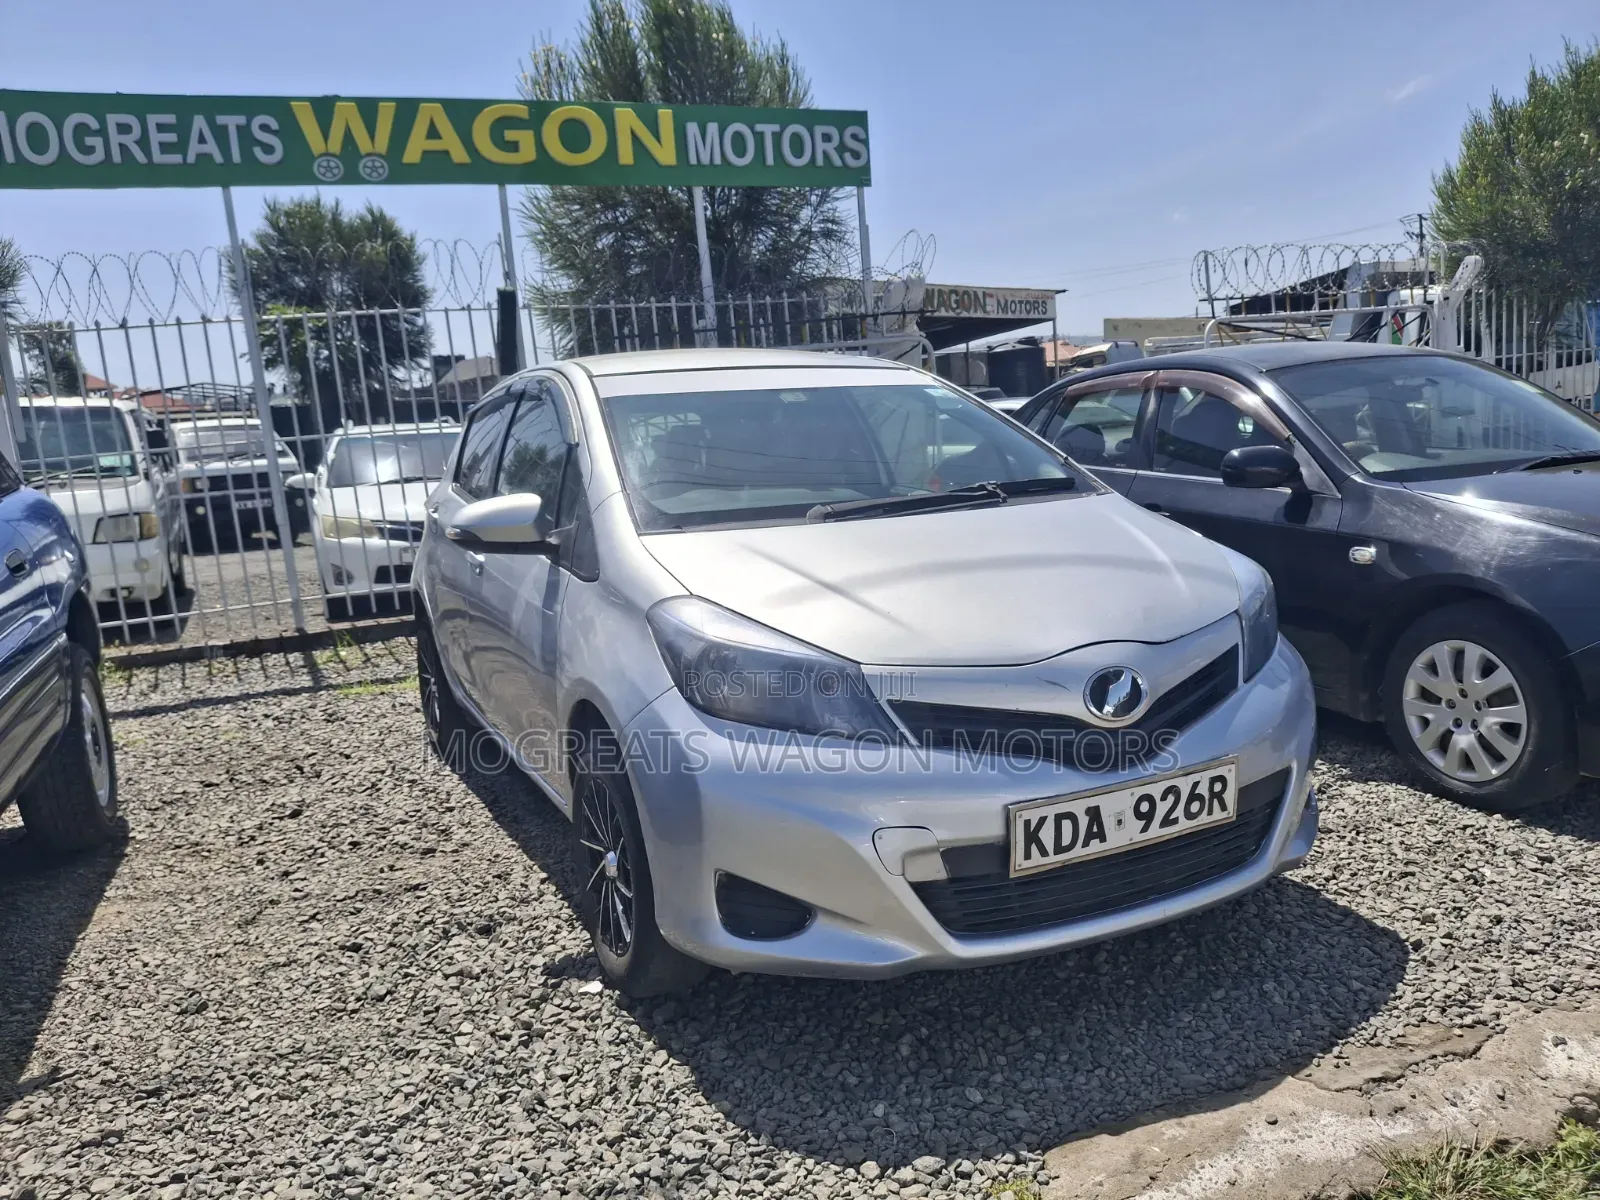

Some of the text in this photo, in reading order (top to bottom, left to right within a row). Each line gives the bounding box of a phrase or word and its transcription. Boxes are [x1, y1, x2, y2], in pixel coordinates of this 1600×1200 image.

[290, 101, 678, 167] WAGON
[685, 121, 868, 168] MOTORS
[996, 299, 1048, 315] MOTORS
[1023, 774, 1229, 861] KDA 926R
